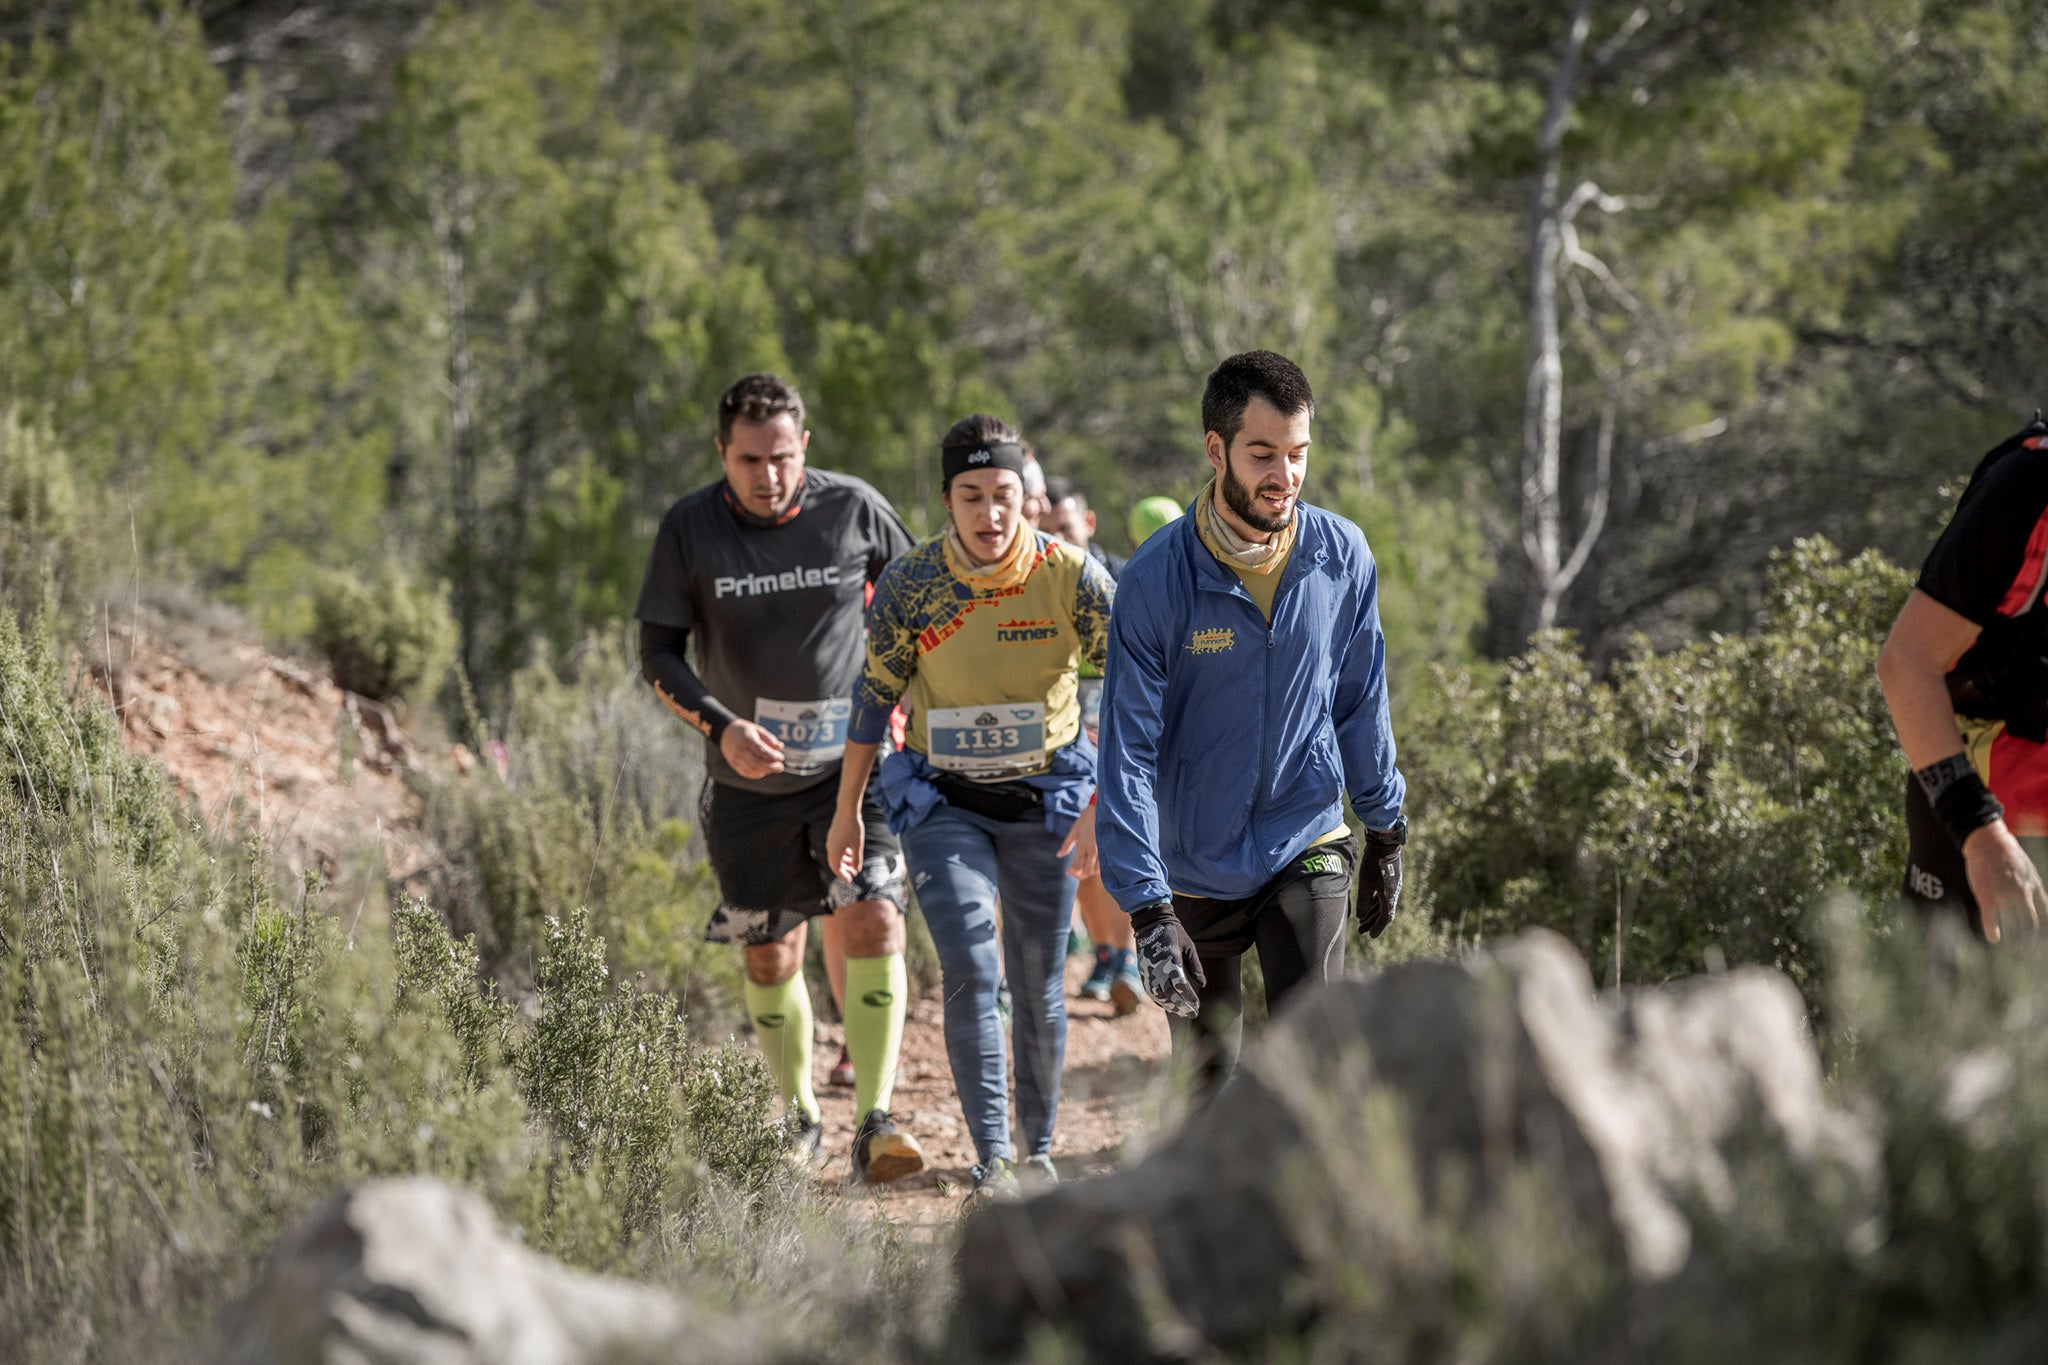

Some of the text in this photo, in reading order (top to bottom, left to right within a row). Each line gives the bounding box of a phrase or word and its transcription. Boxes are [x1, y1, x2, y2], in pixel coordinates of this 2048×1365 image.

[714, 565, 840, 599] Primelec
[997, 627, 1059, 641] runners
[778, 722, 835, 742] 1073
[955, 728, 1020, 750] 1133
